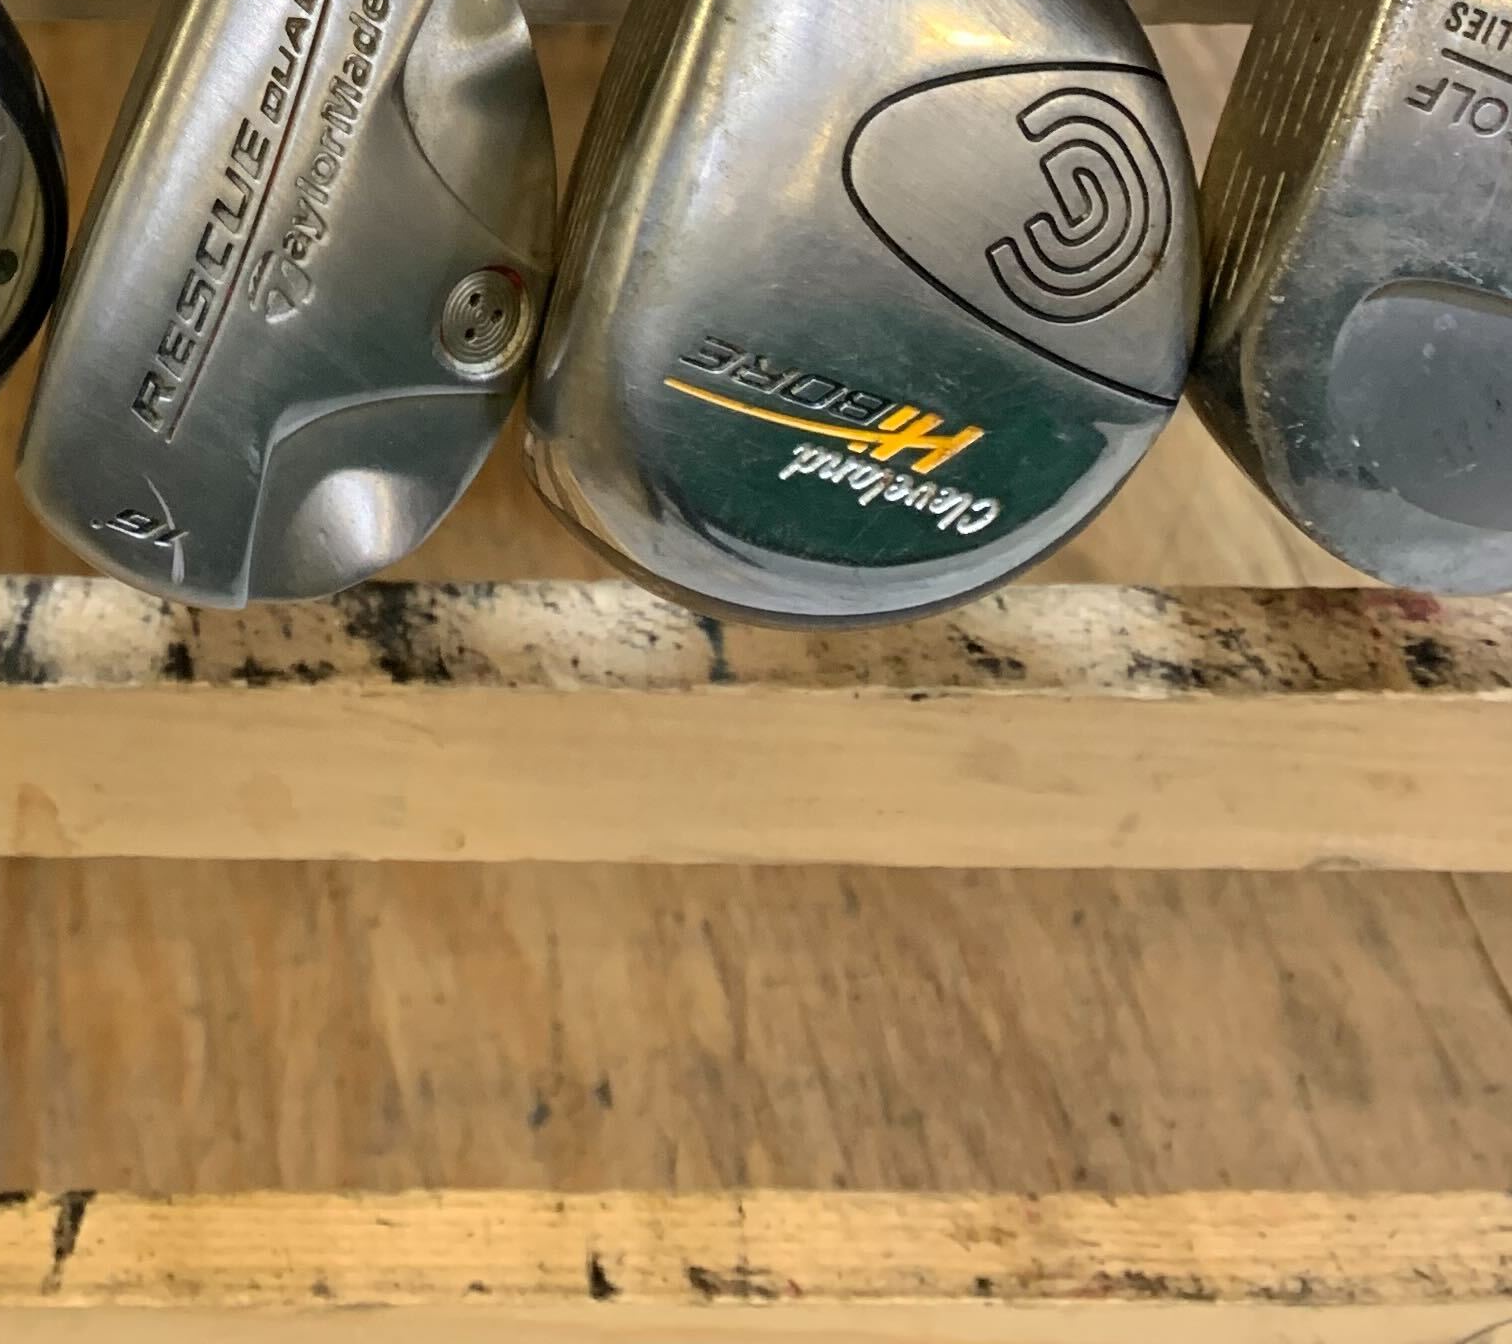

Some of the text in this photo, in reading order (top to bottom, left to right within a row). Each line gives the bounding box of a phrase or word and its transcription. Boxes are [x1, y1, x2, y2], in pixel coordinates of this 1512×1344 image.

[1404, 77, 1512, 144] OLF
[130, 116, 271, 434] RESCUE
[779, 443, 1000, 537] Cleveland
